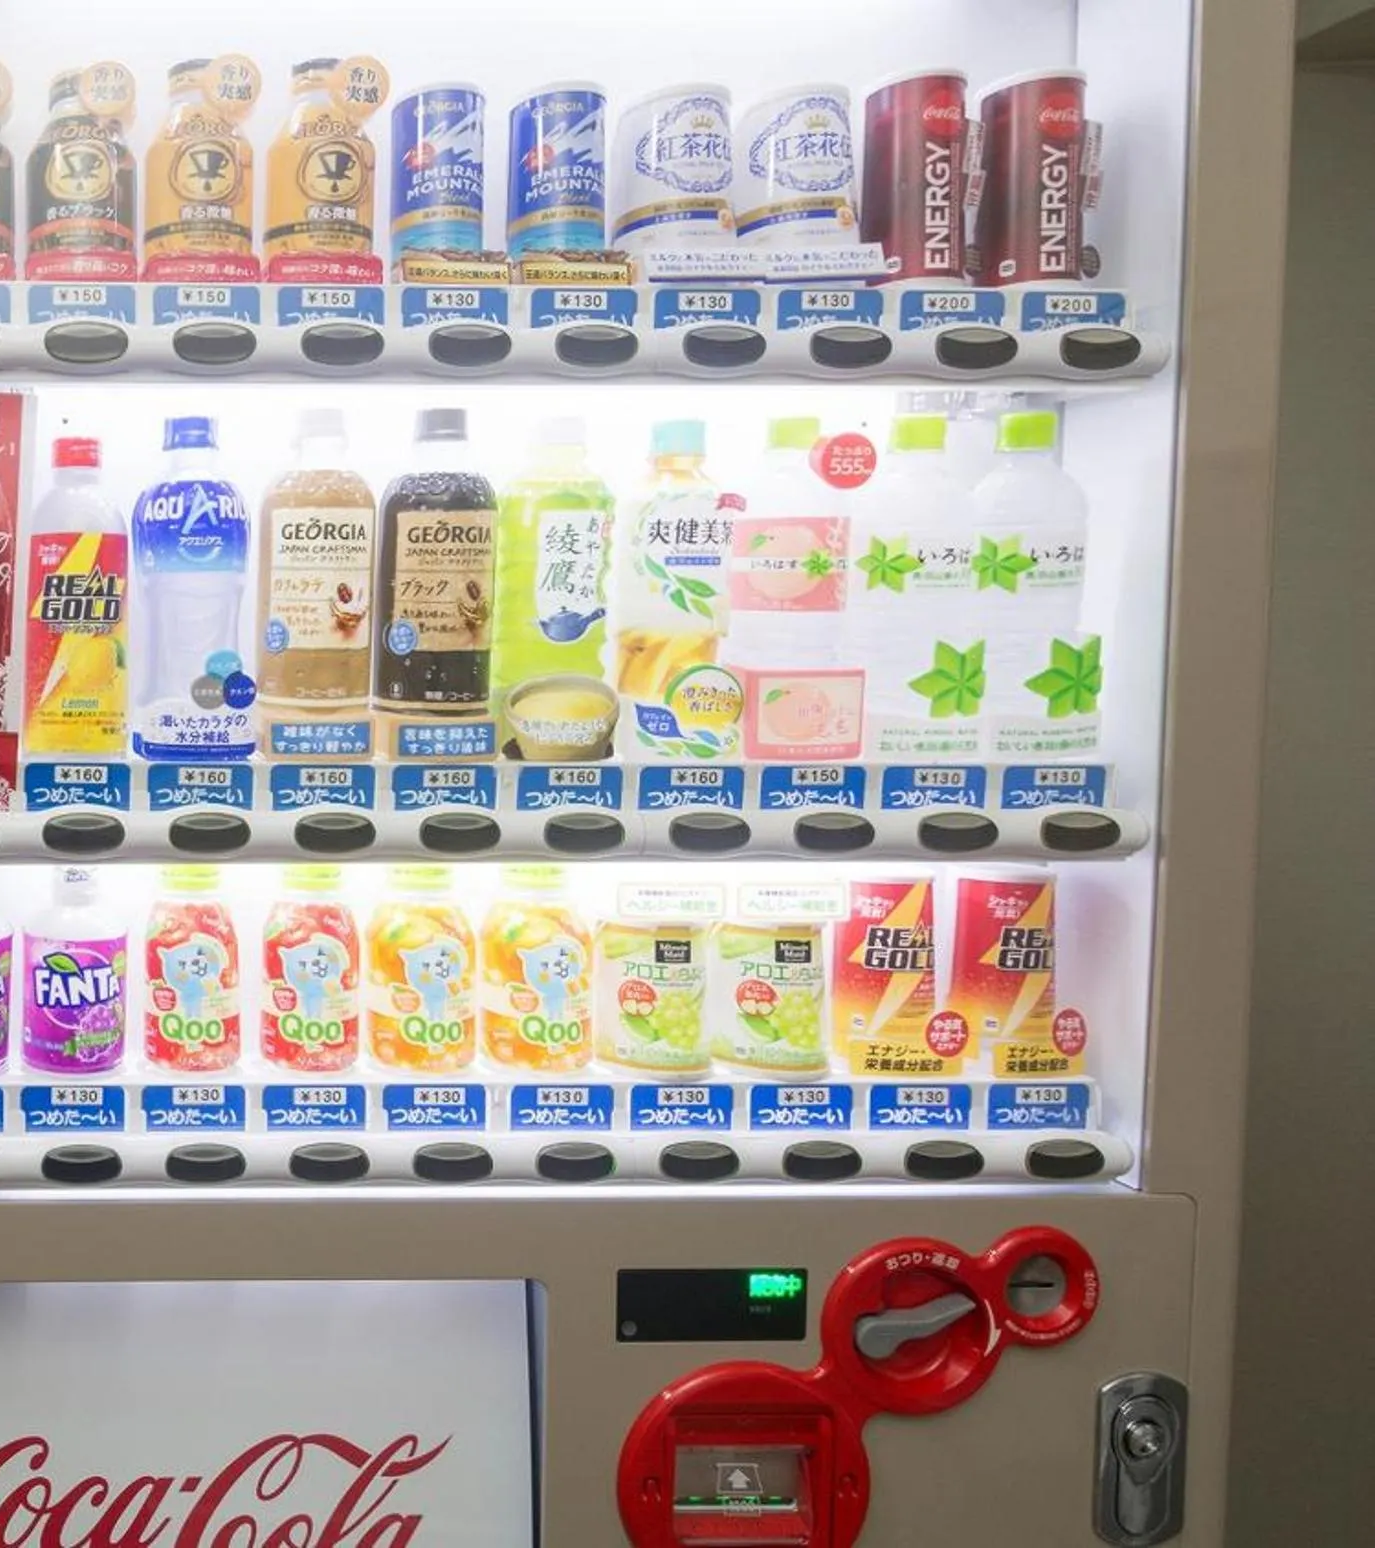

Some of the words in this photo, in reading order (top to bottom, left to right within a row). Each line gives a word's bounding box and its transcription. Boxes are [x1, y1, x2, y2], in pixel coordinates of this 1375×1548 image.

[349, 67, 376, 83] 香り
[925, 141, 951, 269] ENERGY
[1039, 143, 1067, 272] ENERGY
[59, 288, 102, 302] ¥150
[182, 289, 226, 303] ¥150
[306, 291, 351, 305] ¥150
[432, 292, 475, 306] ¥130
[559, 293, 603, 308] ¥130
[684, 294, 728, 309] ¥130
[806, 293, 850, 308] ¥130
[927, 296, 970, 310] ¥200
[1050, 297, 1093, 312] ¥200
[404, 547, 439, 557] JAPAN
[541, 523, 582, 594] 綾鷹
[579, 516, 600, 596] あやたか
[43, 565, 122, 598] REAL
[400, 578, 450, 597] ブラック
[40, 598, 122, 622] GOLD
[283, 725, 356, 738] 雑味がなく
[275, 740, 366, 754] すっきり軽やか
[60, 769, 103, 782] ¥160
[184, 770, 227, 783] ¥160
[305, 771, 347, 784] ¥160
[428, 771, 471, 784] ¥160
[553, 770, 597, 783] ¥160
[676, 771, 718, 784] ¥160
[797, 770, 840, 783] ¥150
[918, 771, 961, 784] ¥130
[1039, 771, 1081, 784] ¥130
[34, 967, 120, 1006] FANTA
[162, 1013, 222, 1042] Qoo
[280, 1012, 342, 1042] Qoo
[403, 1014, 462, 1043] Qoo
[522, 1014, 582, 1043] Qoo
[864, 1058, 944, 1073] 栄養成分配合
[1005, 1059, 1069, 1073] 栄養成分配合
[55, 1089, 98, 1103] ¥130
[177, 1088, 221, 1102] ¥130
[300, 1089, 342, 1103] ¥130
[419, 1089, 461, 1103] ¥130
[541, 1089, 583, 1103] ¥130
[662, 1089, 705, 1103] ¥130
[784, 1089, 825, 1103] ¥130
[903, 1089, 946, 1103] ¥130
[1021, 1088, 1062, 1102] ¥130
